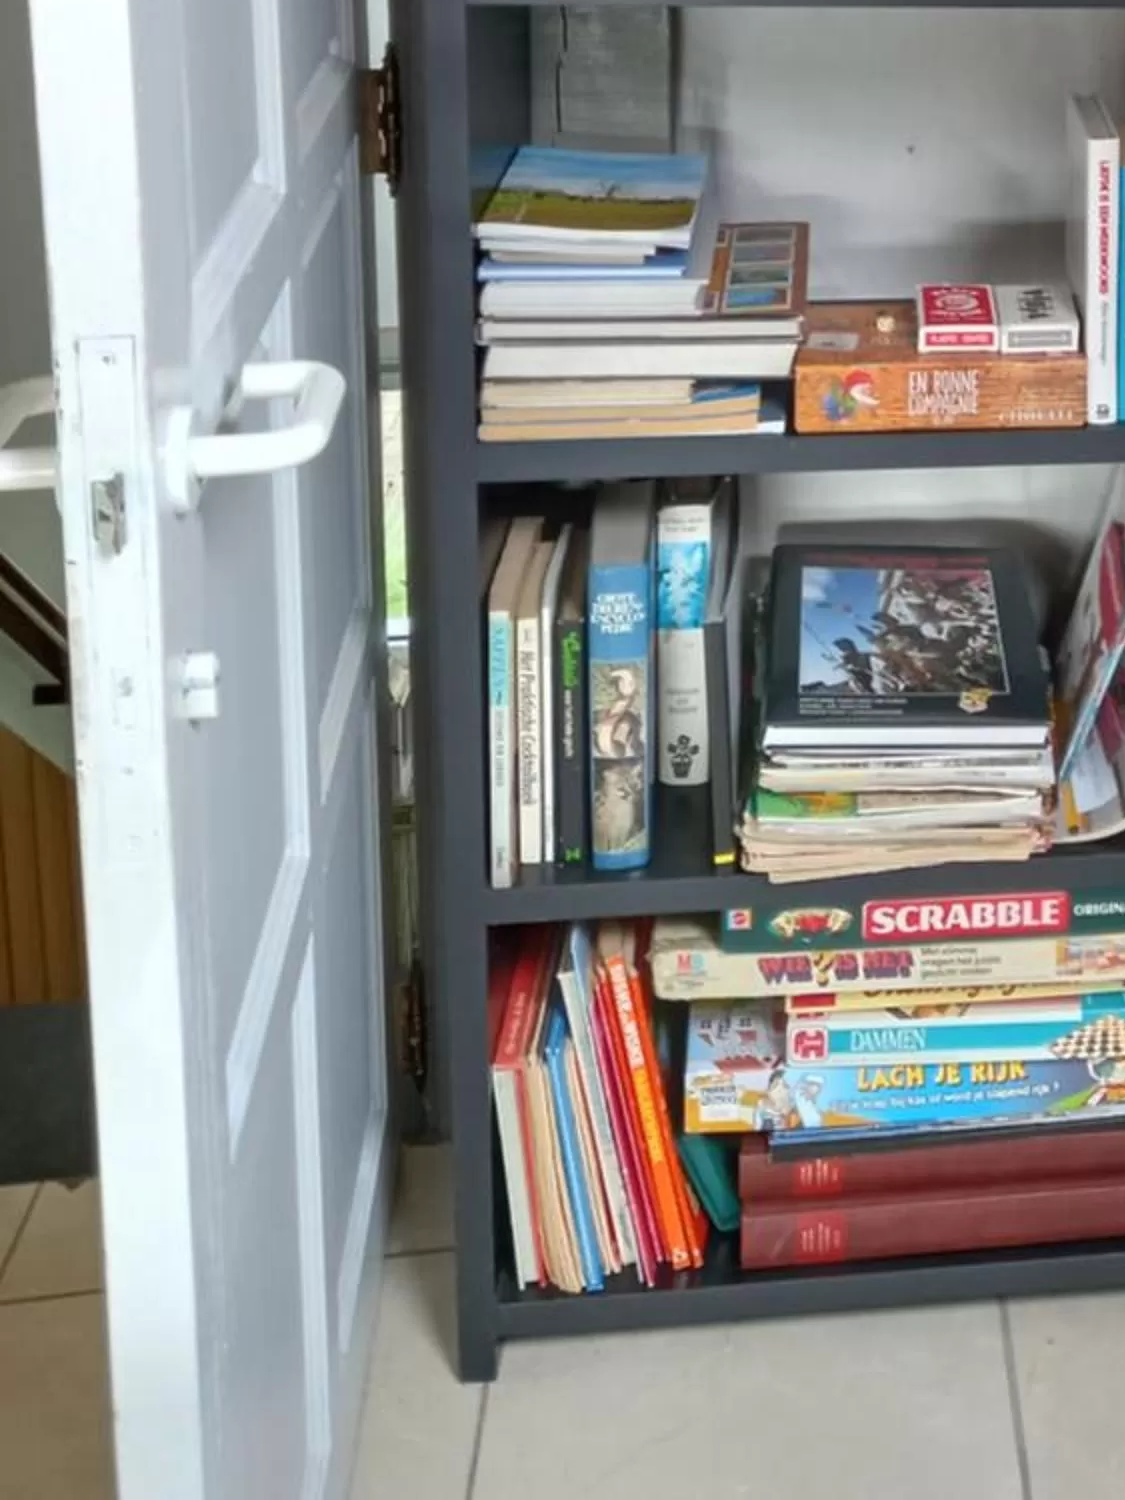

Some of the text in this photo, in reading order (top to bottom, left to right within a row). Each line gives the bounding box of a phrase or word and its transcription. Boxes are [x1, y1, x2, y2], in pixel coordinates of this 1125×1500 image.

[869, 897, 1062, 936] SCRABBLE
[851, 1026, 926, 1052] DAMMEN
[857, 1060, 1030, 1092] LACH JE RIJK
